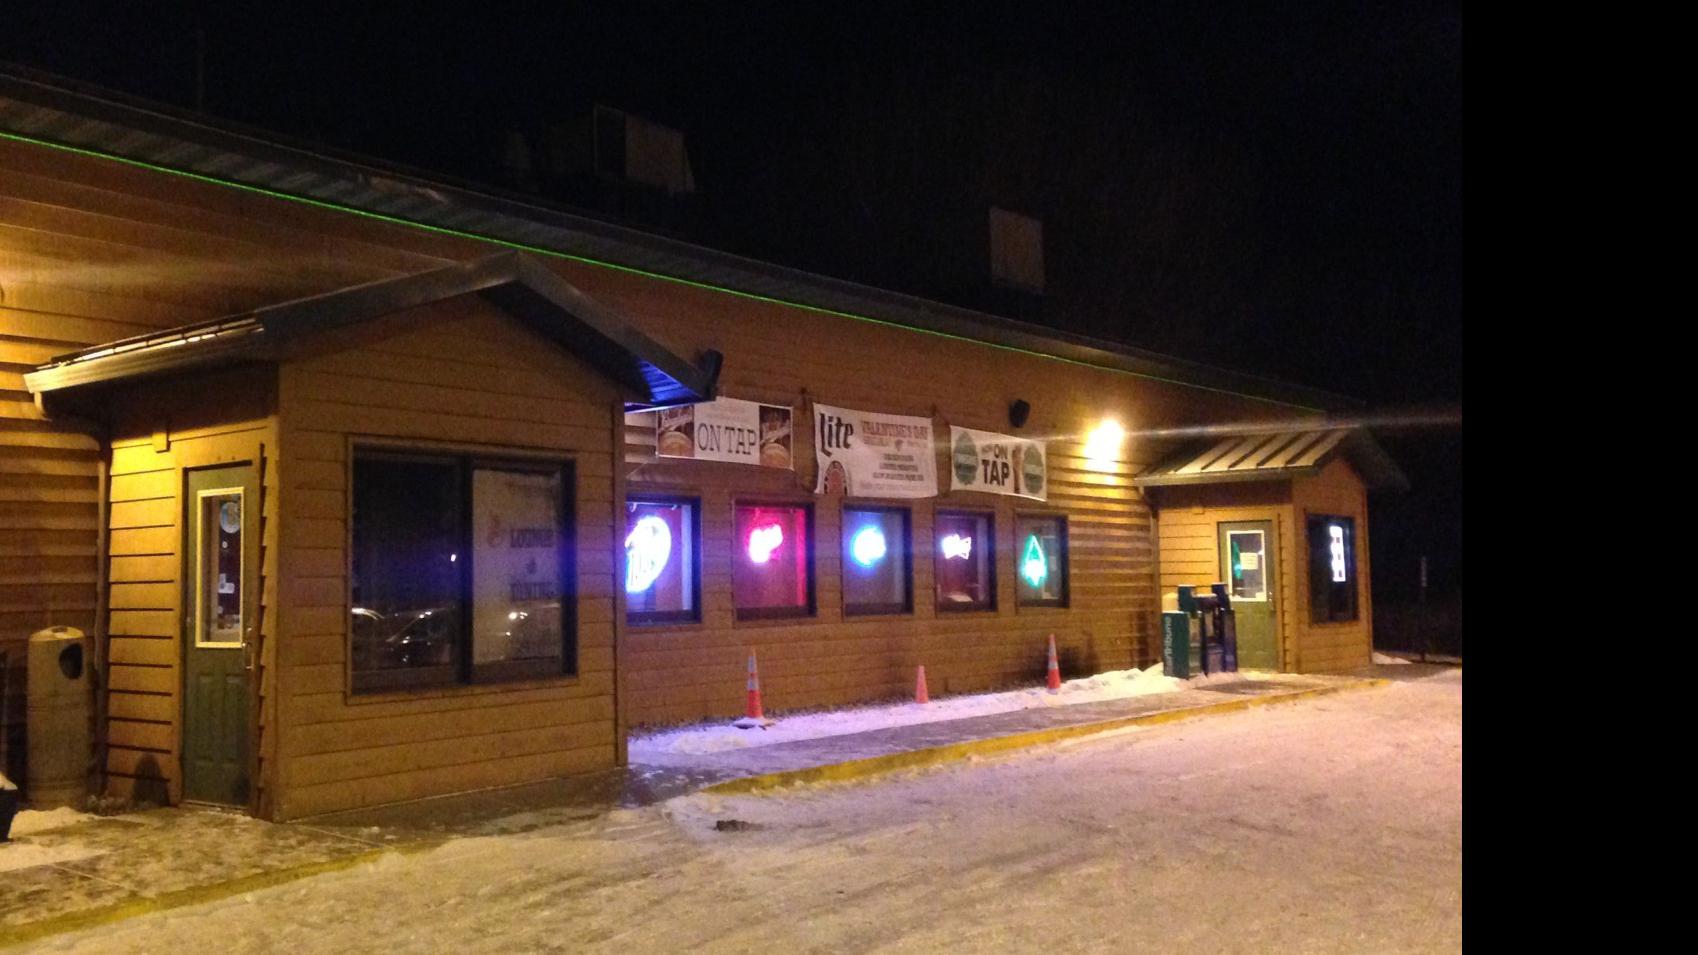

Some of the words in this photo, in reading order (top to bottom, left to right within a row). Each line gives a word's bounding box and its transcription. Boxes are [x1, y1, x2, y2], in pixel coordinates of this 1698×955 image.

[697, 422, 721, 452] ON
[725, 426, 756, 455] TAP
[819, 411, 854, 457] Lite
[993, 443, 1008, 460] ON
[982, 459, 1010, 486] TAP
